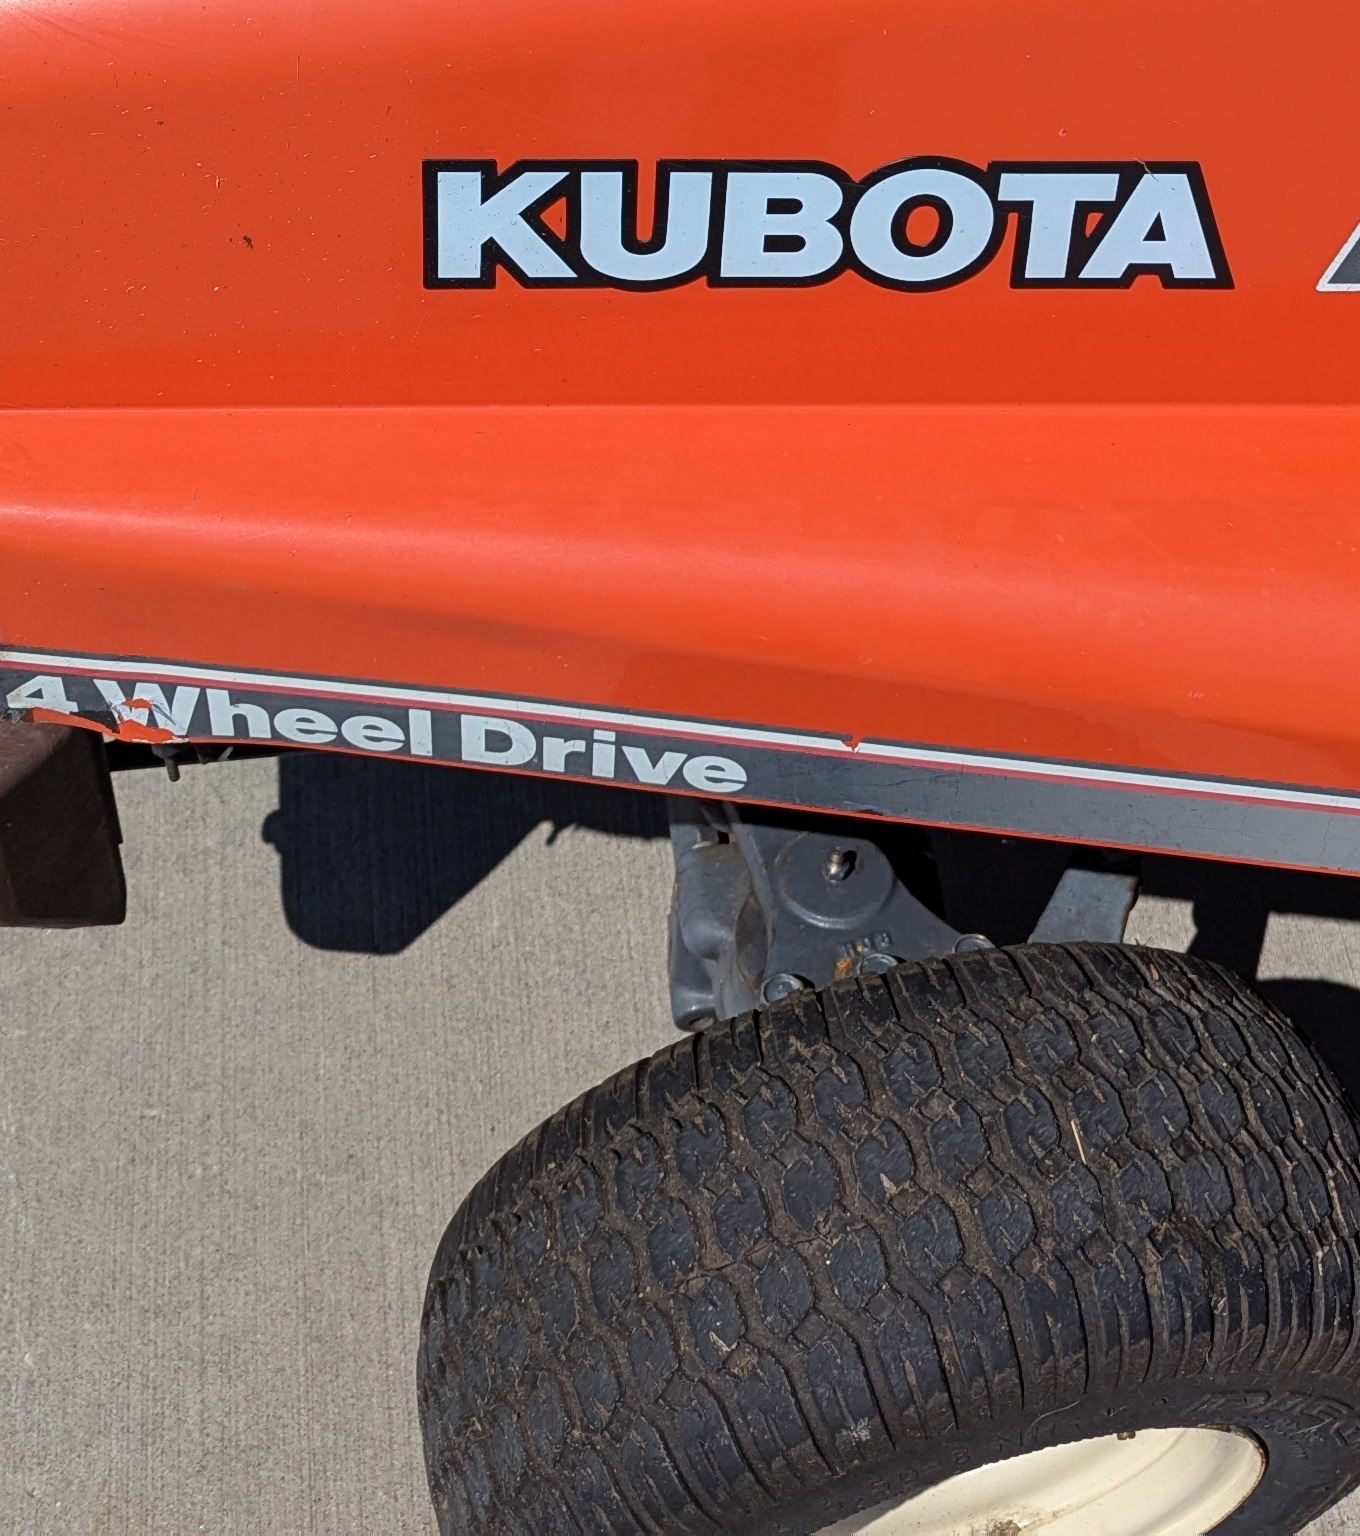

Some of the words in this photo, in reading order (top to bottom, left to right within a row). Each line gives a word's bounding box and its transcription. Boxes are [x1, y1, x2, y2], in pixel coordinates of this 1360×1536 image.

[426, 162, 1228, 287] KUBOTA
[6, 675, 79, 714] 4
[93, 677, 433, 756] Wheel
[460, 712, 748, 794] Drive
